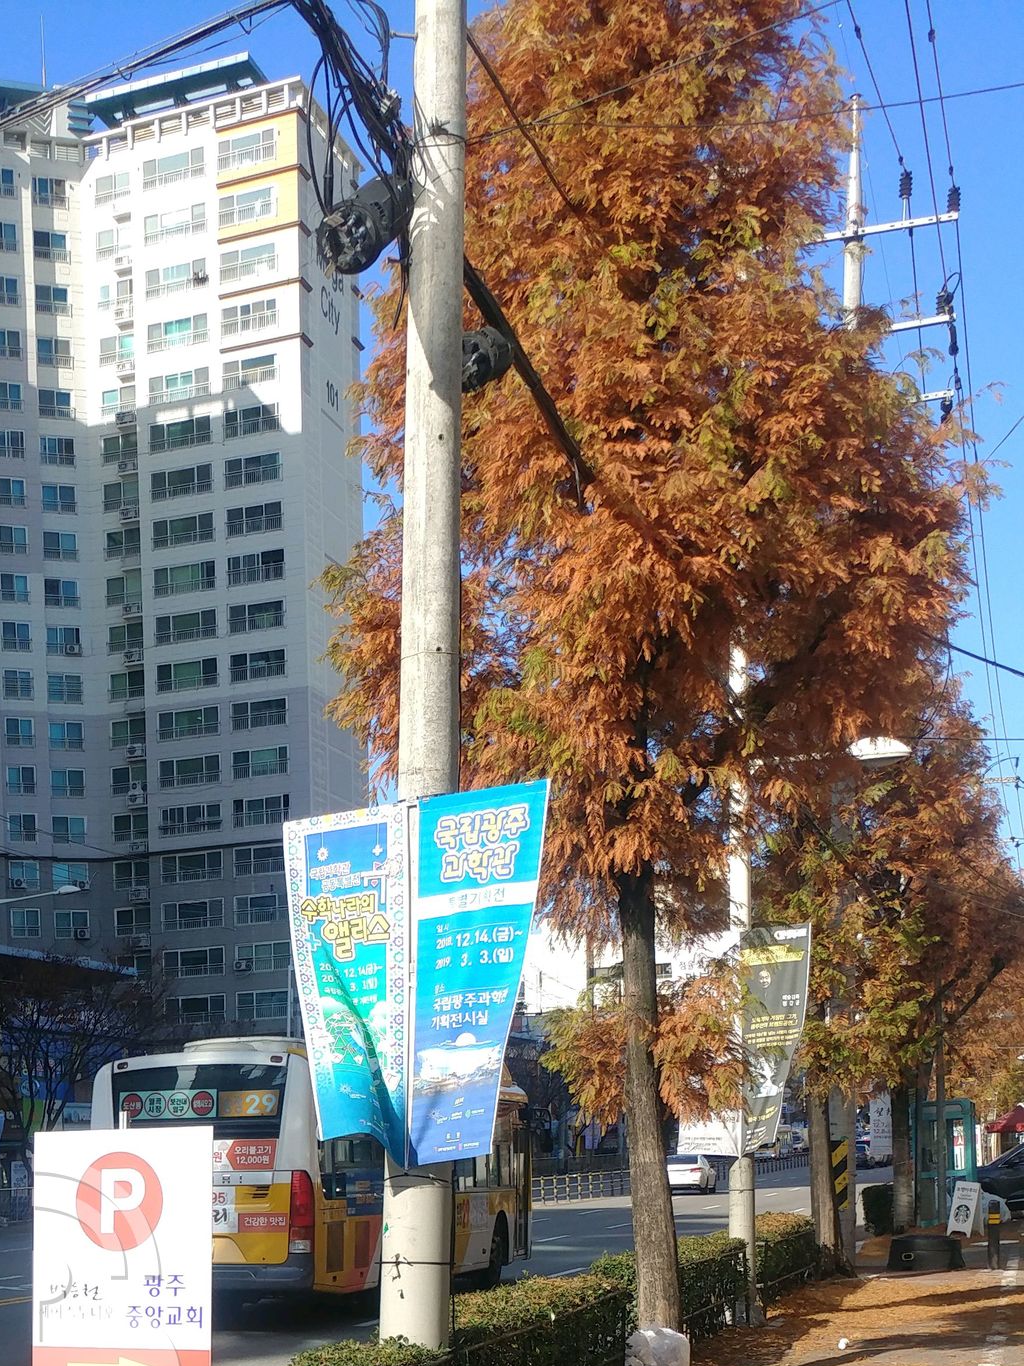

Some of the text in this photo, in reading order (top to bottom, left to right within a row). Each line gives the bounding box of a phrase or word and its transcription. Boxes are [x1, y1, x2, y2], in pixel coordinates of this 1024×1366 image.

[320, 285, 341, 335] City
[325, 379, 340, 412] 101
[436, 805, 527, 850] 국립광주
[309, 862, 352, 880] 국립과학관
[442, 843, 518, 881] 과학관
[300, 893, 377, 922] 수학나라의
[322, 913, 391, 960] 앨리스
[431, 1010, 489, 1031] 기획전시실
[245, 1093, 277, 1114] 29
[233, 1145, 272, 1155] 오리불고기
[236, 1156, 270, 1165] 12,000원
[99, 1167, 146, 1235] P
[244, 1216, 286, 1226] 건강한 맛집
[142, 1274, 187, 1298] 광주
[125, 1304, 203, 1329] 중앙교회
